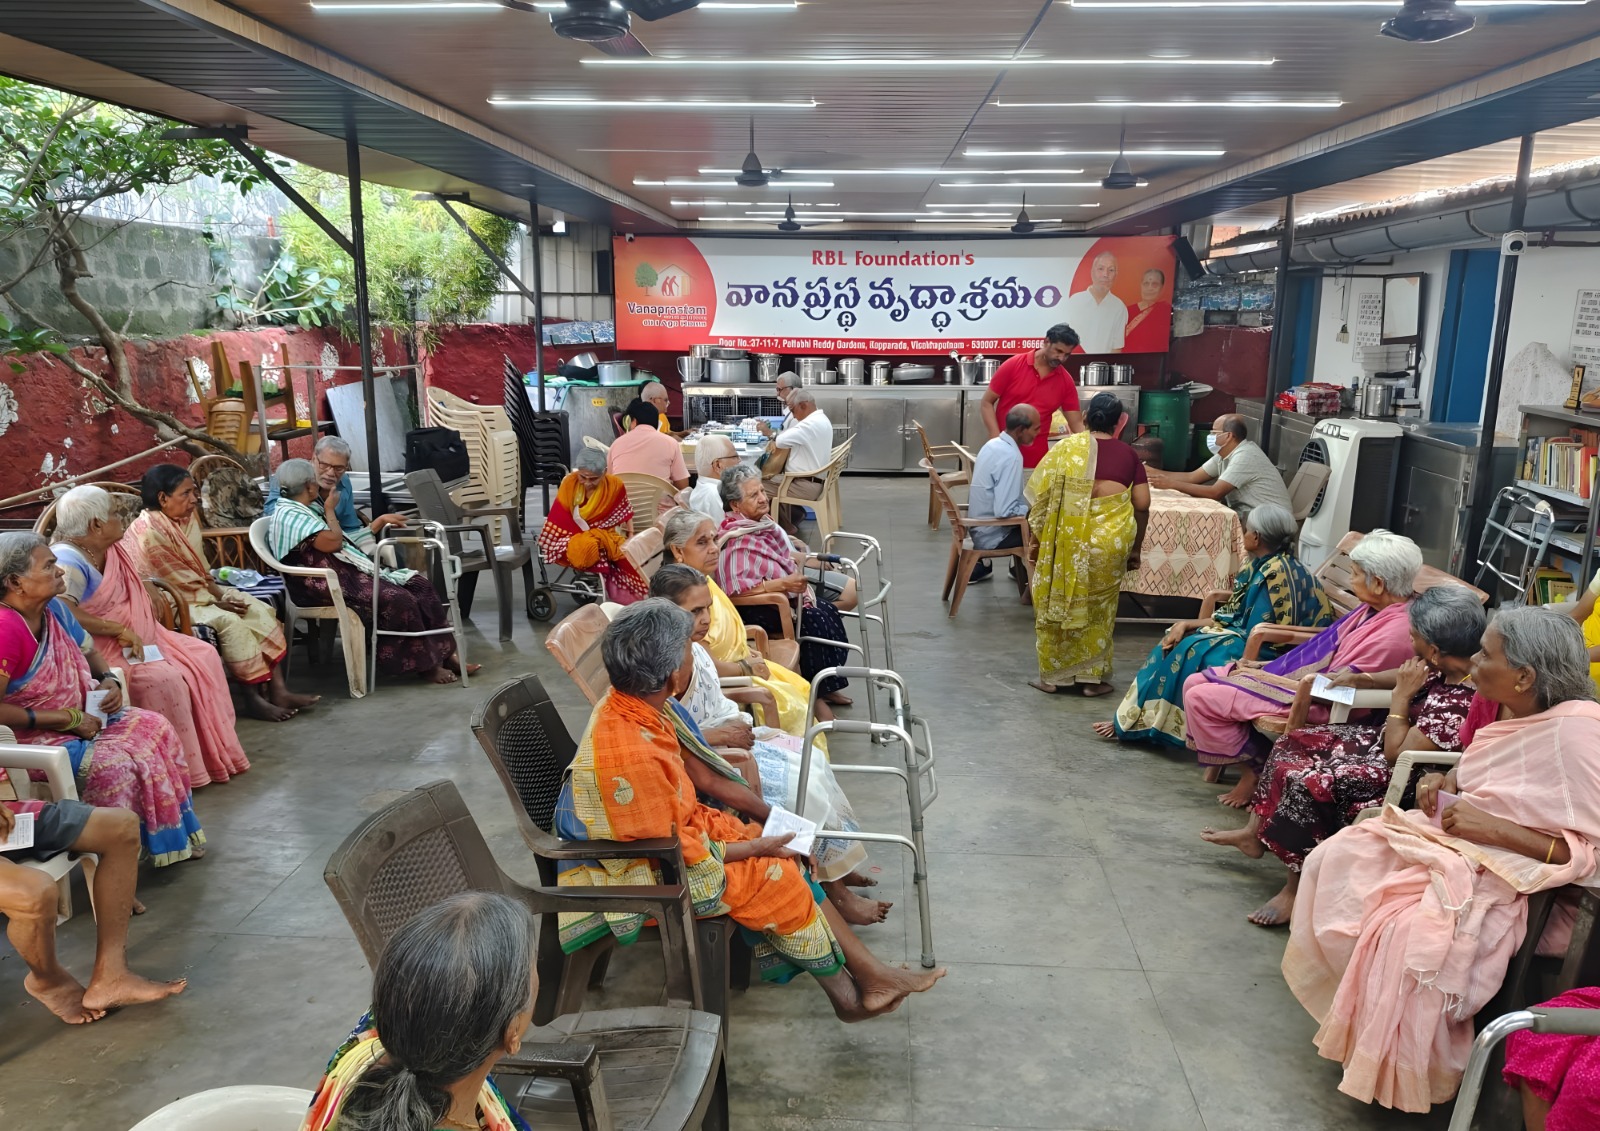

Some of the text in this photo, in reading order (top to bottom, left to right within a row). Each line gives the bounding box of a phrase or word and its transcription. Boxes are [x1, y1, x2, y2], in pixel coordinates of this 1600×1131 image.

[812, 249, 975, 266] RBL Foundation's
[627, 302, 707, 317] Vanaprastam
[1002, 340, 1016, 349] Cell
